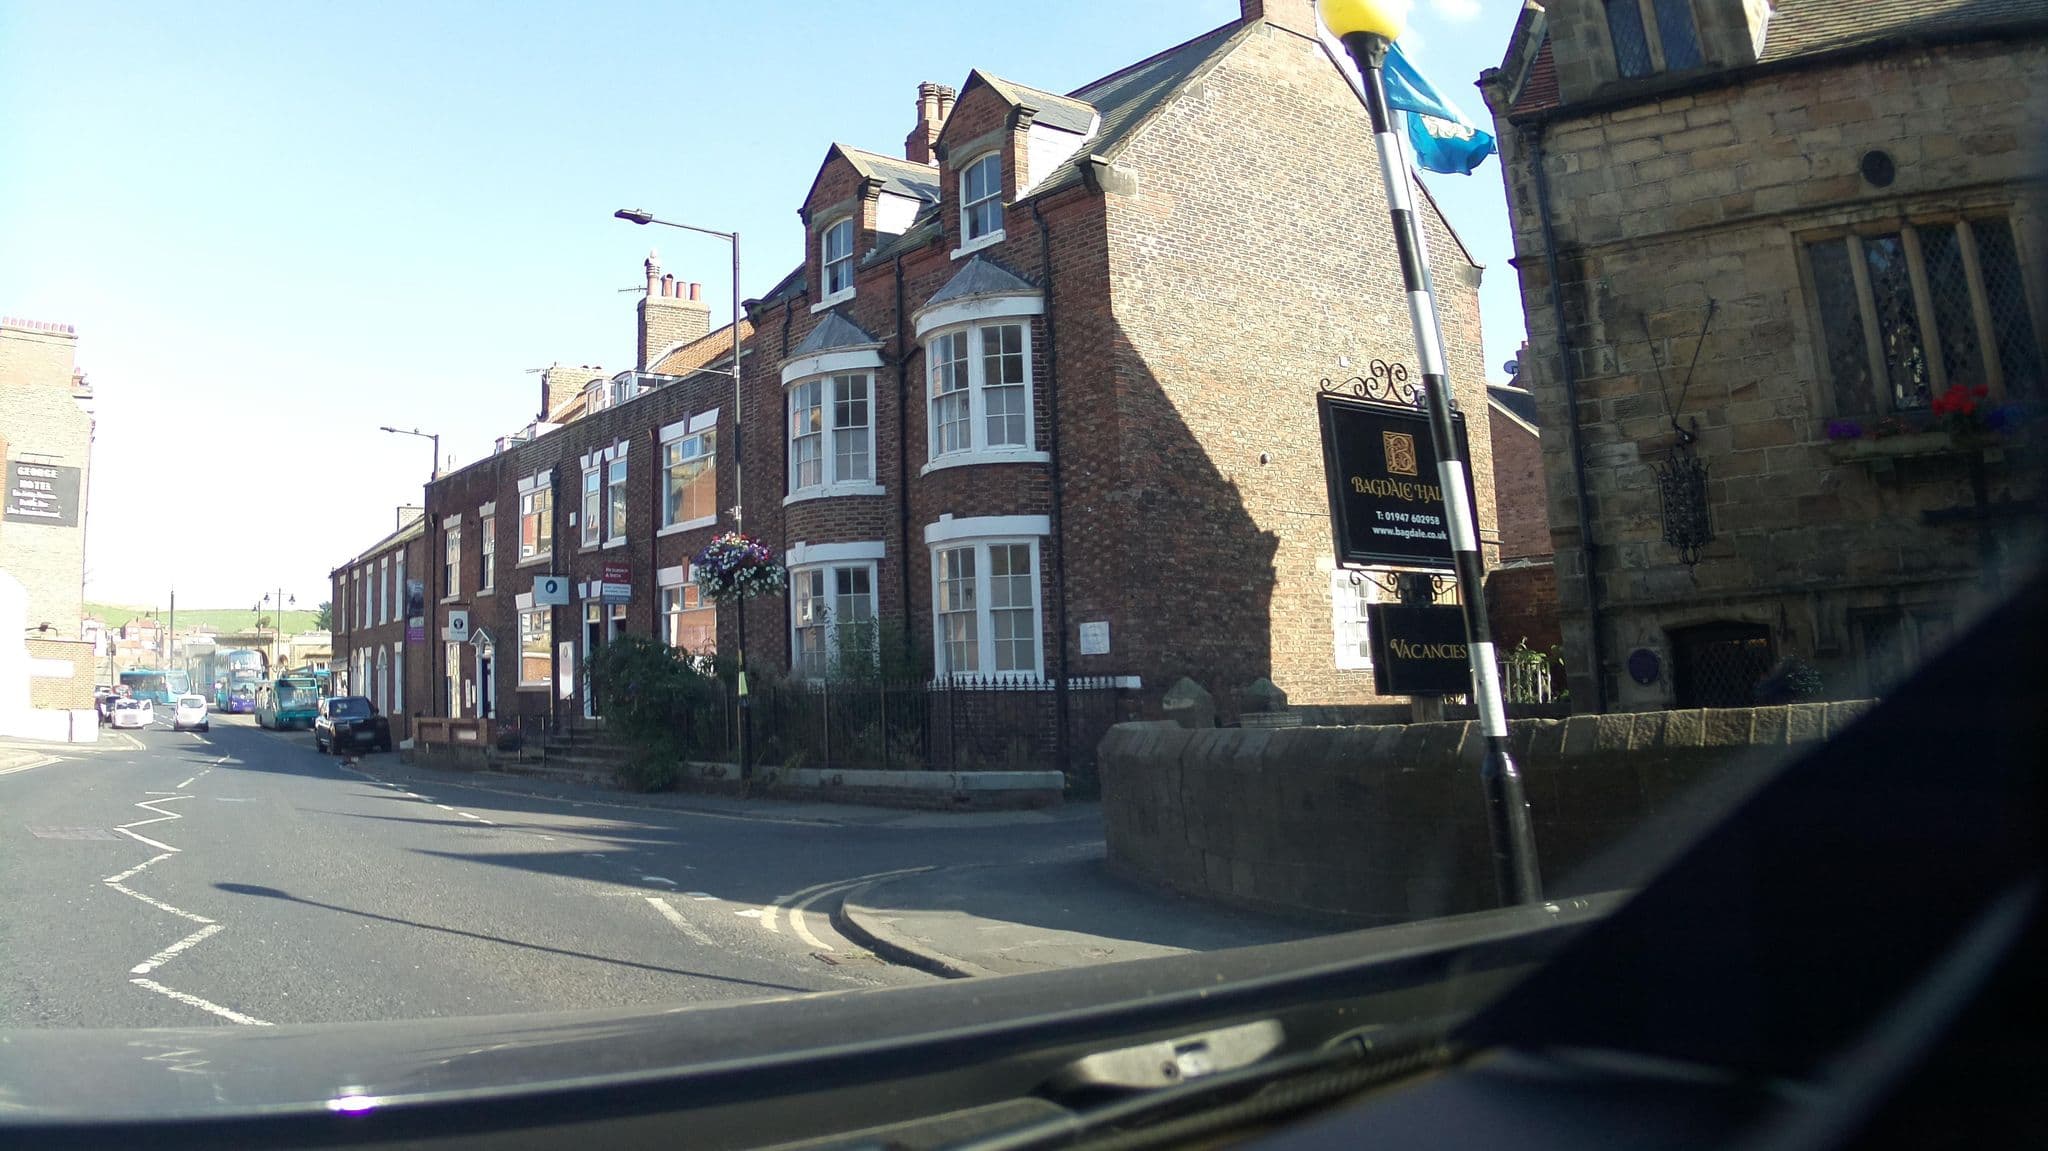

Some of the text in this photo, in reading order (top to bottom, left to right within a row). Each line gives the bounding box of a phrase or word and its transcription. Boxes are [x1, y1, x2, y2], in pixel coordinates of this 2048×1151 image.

[17, 466, 59, 479] GEORGE
[19, 480, 52, 491] HOTEL
[1351, 476, 1444, 504] BAGDALE HAL
[1376, 511, 1440, 525] T: 01947 602958
[1372, 526, 1448, 540] www.bagdale.co.uk
[1390, 638, 1467, 659] VACANCIES
